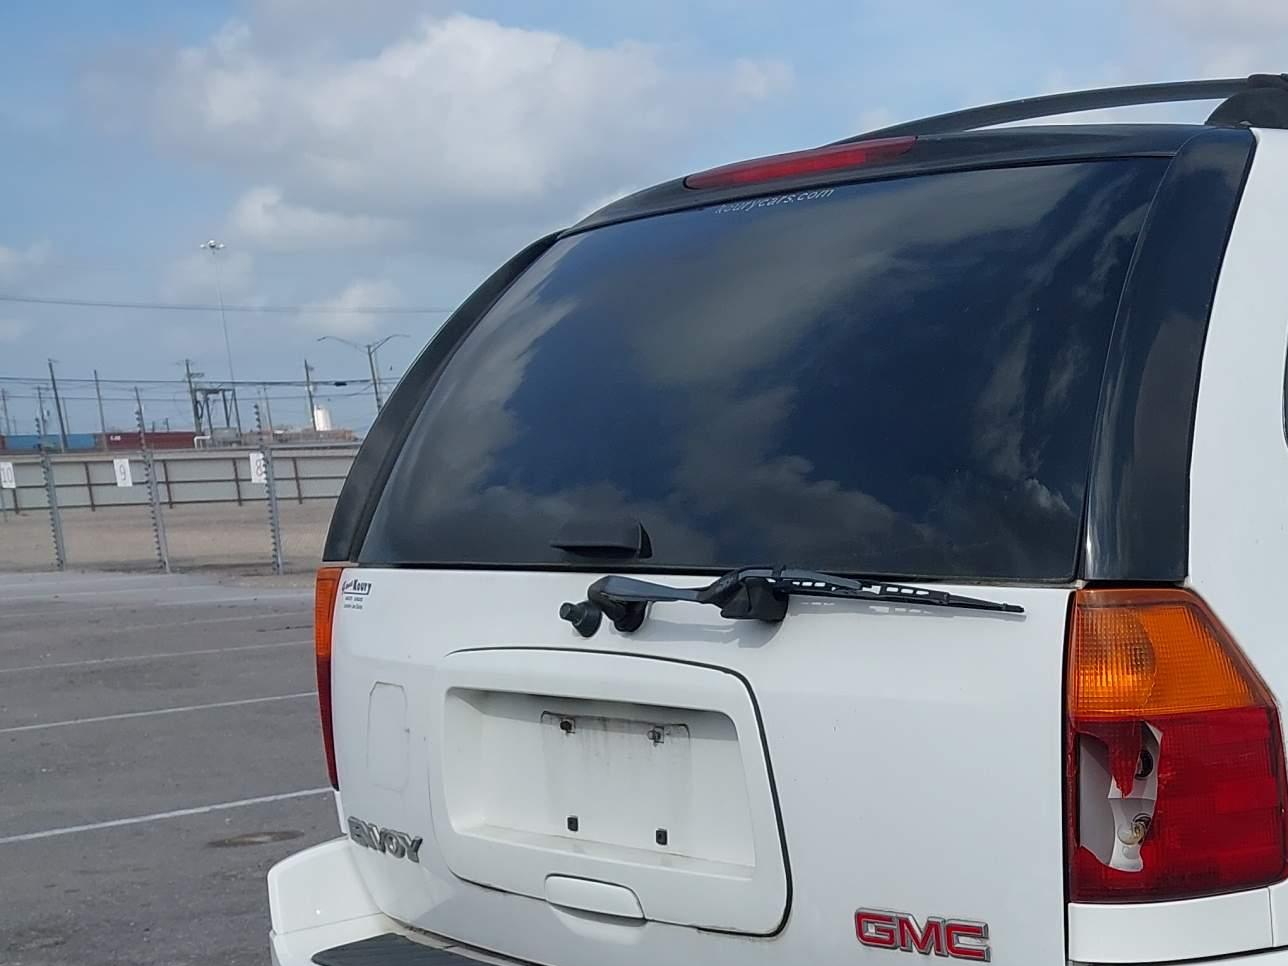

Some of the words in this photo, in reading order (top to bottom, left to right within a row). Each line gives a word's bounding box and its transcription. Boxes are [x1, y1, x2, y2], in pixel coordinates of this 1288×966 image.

[118, 463, 127, 481] 9
[347, 815, 423, 864] ENVOY
[855, 907, 991, 963] GMC
